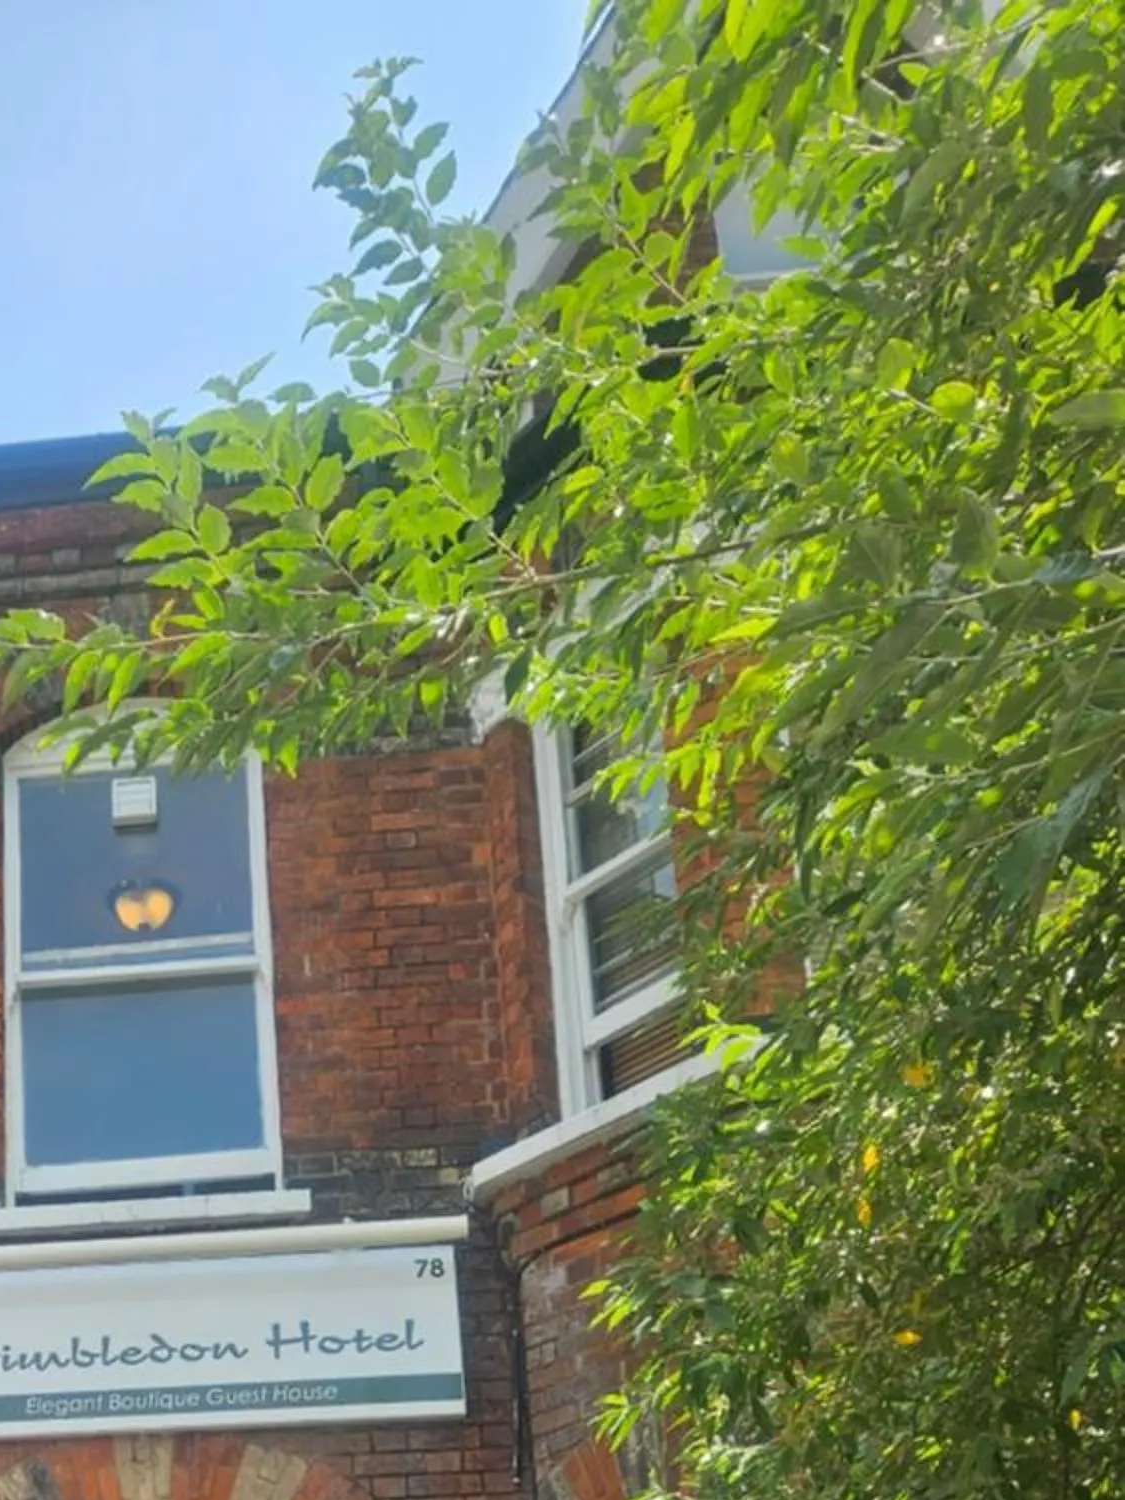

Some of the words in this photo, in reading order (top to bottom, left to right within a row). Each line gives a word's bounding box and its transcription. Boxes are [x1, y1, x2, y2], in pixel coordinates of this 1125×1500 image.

[414, 1258, 445, 1279] 78
[265, 1318, 425, 1360] Hotel
[26, 1395, 102, 1416] Elegant
[108, 1391, 200, 1411] Boutique
[206, 1385, 267, 1405] Guest
[273, 1384, 339, 1402] House
